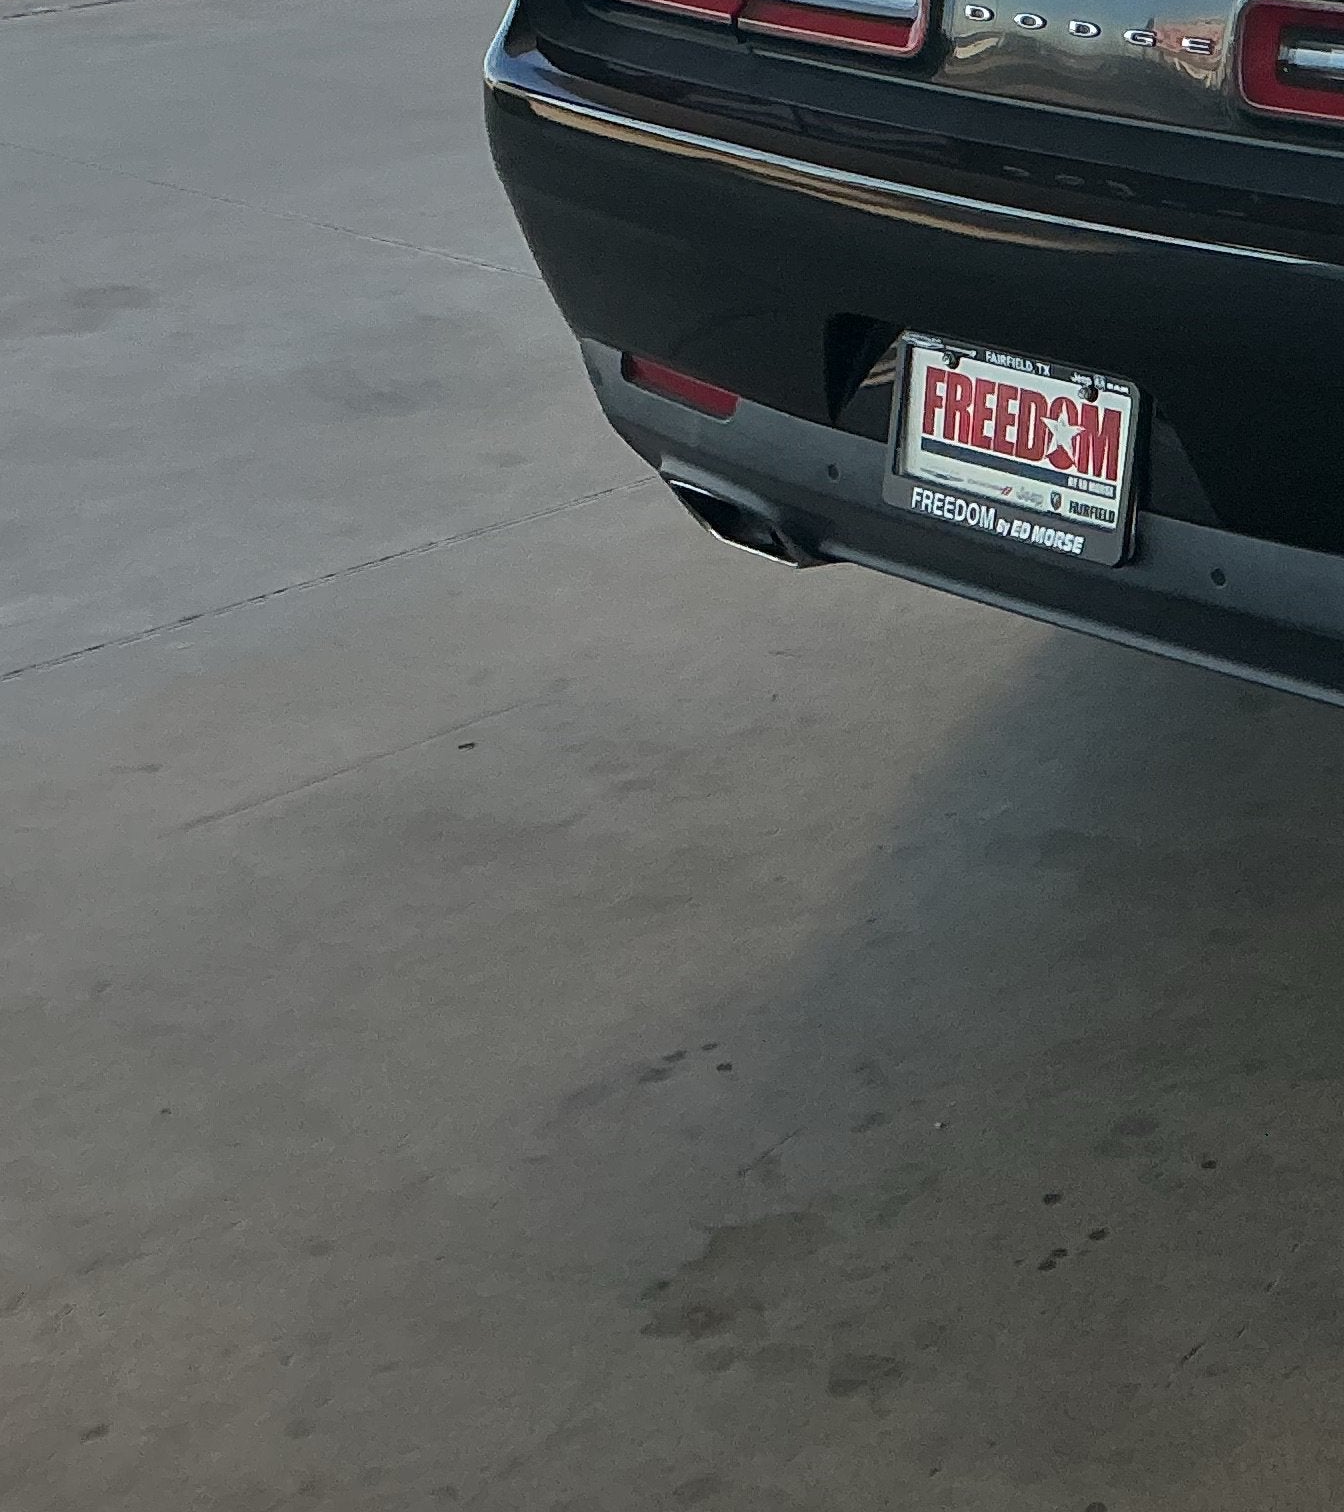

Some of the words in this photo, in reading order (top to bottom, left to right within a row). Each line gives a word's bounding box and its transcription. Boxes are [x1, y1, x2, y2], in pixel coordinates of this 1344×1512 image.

[964, 3, 1214, 56] DODGE
[1036, 361, 1051, 377] TX
[922, 366, 1122, 481] FREEDOM
[911, 486, 996, 530] FREEDOM
[1010, 519, 1032, 540] ED
[1031, 524, 1085, 555] MORSE
